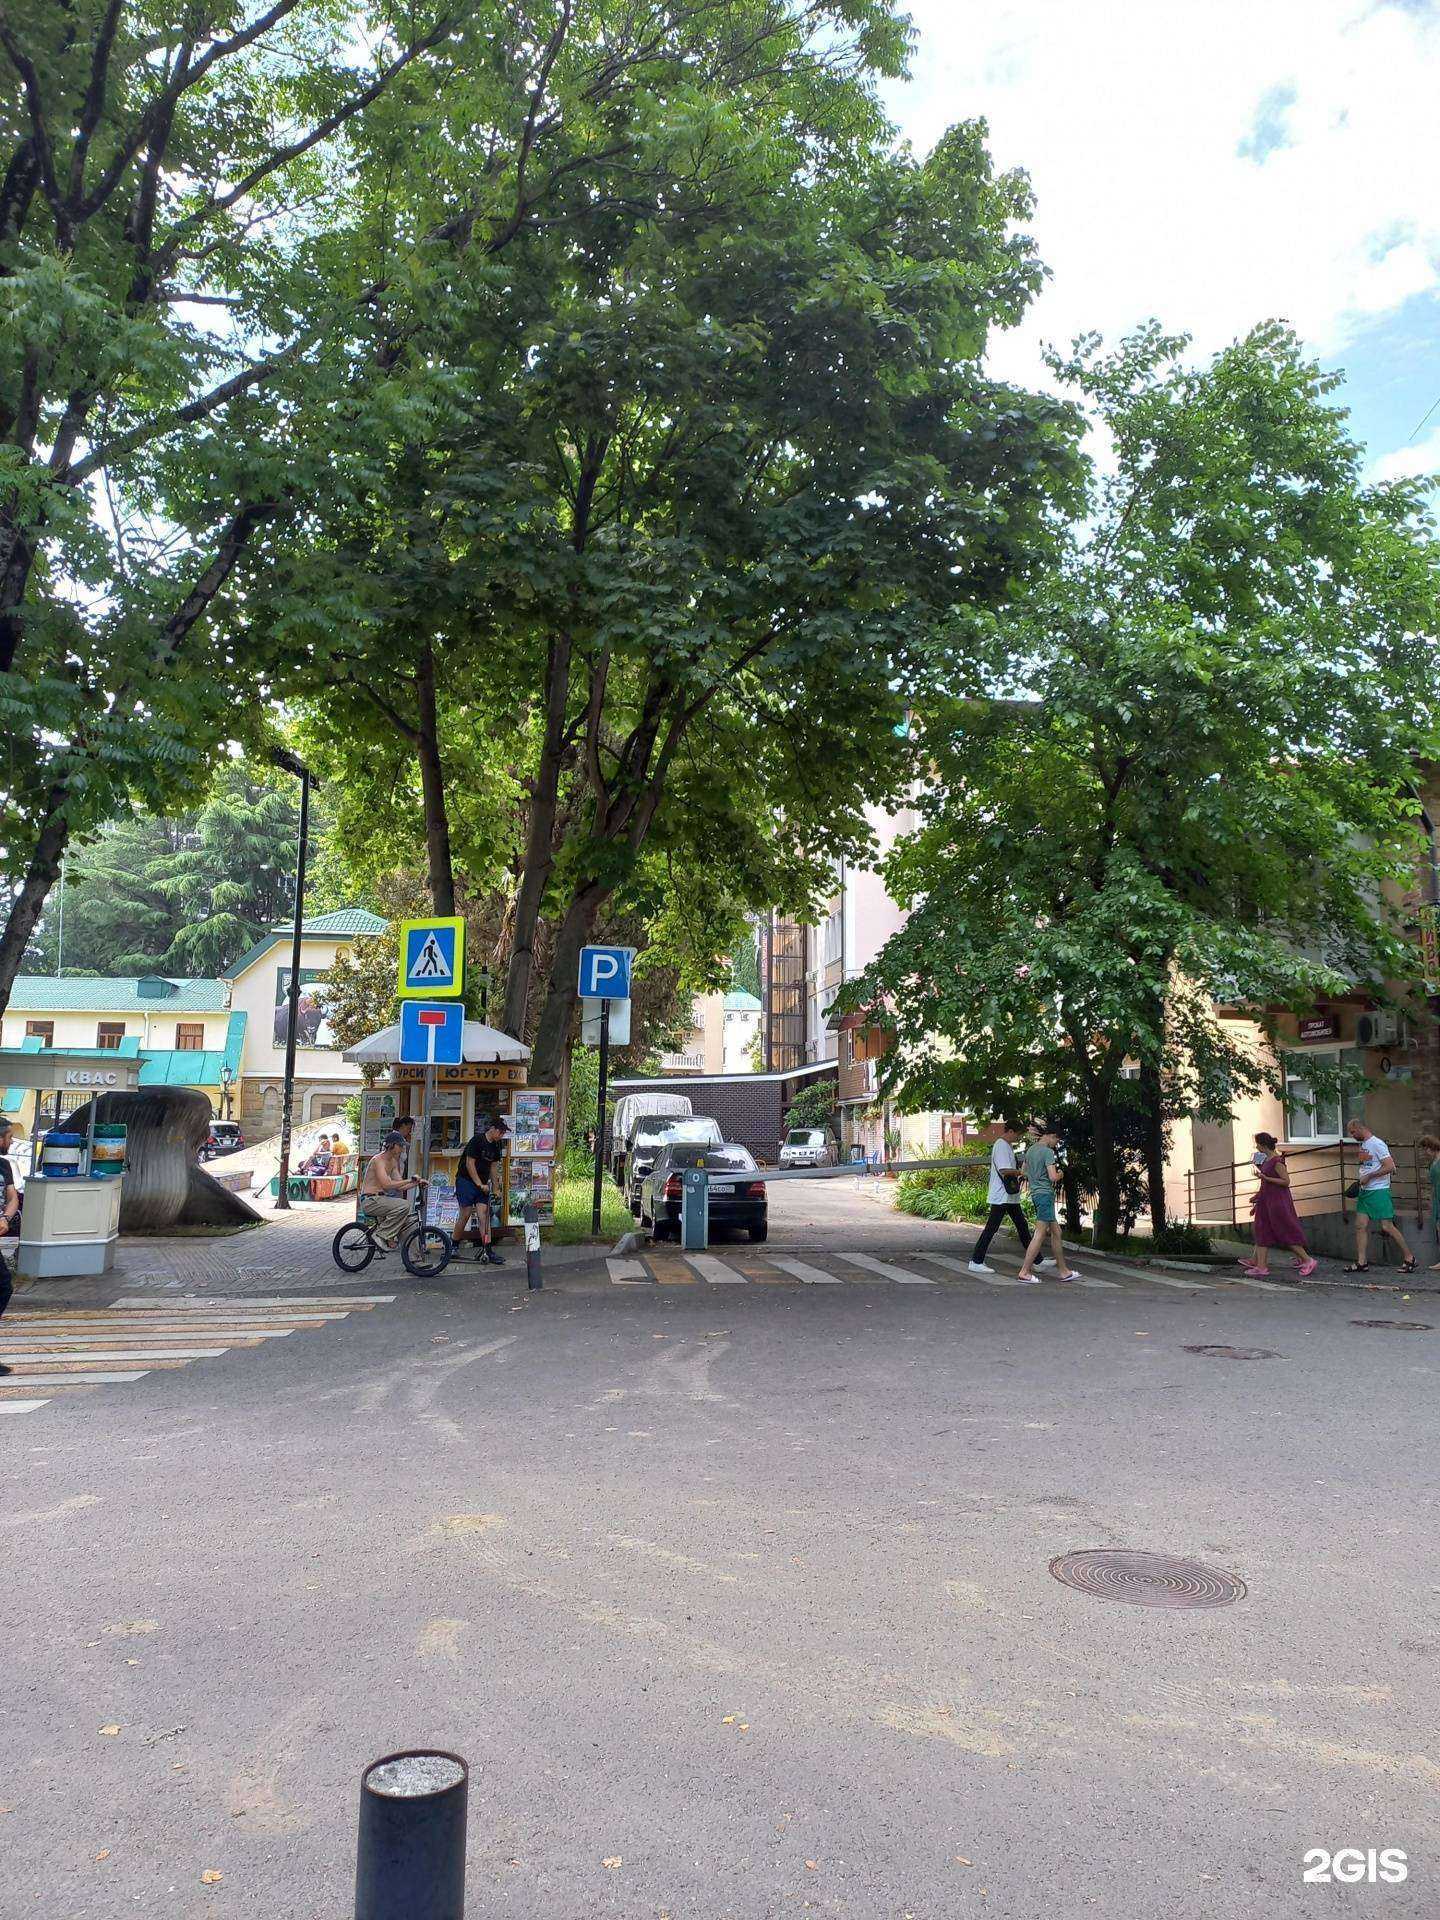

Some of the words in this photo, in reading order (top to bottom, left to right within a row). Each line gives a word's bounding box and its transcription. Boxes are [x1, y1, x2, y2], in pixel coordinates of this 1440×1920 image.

[590, 954, 619, 992] P
[65, 1070, 117, 1085] КВАС
[445, 1068, 500, 1079] ЮГ-ТУР
